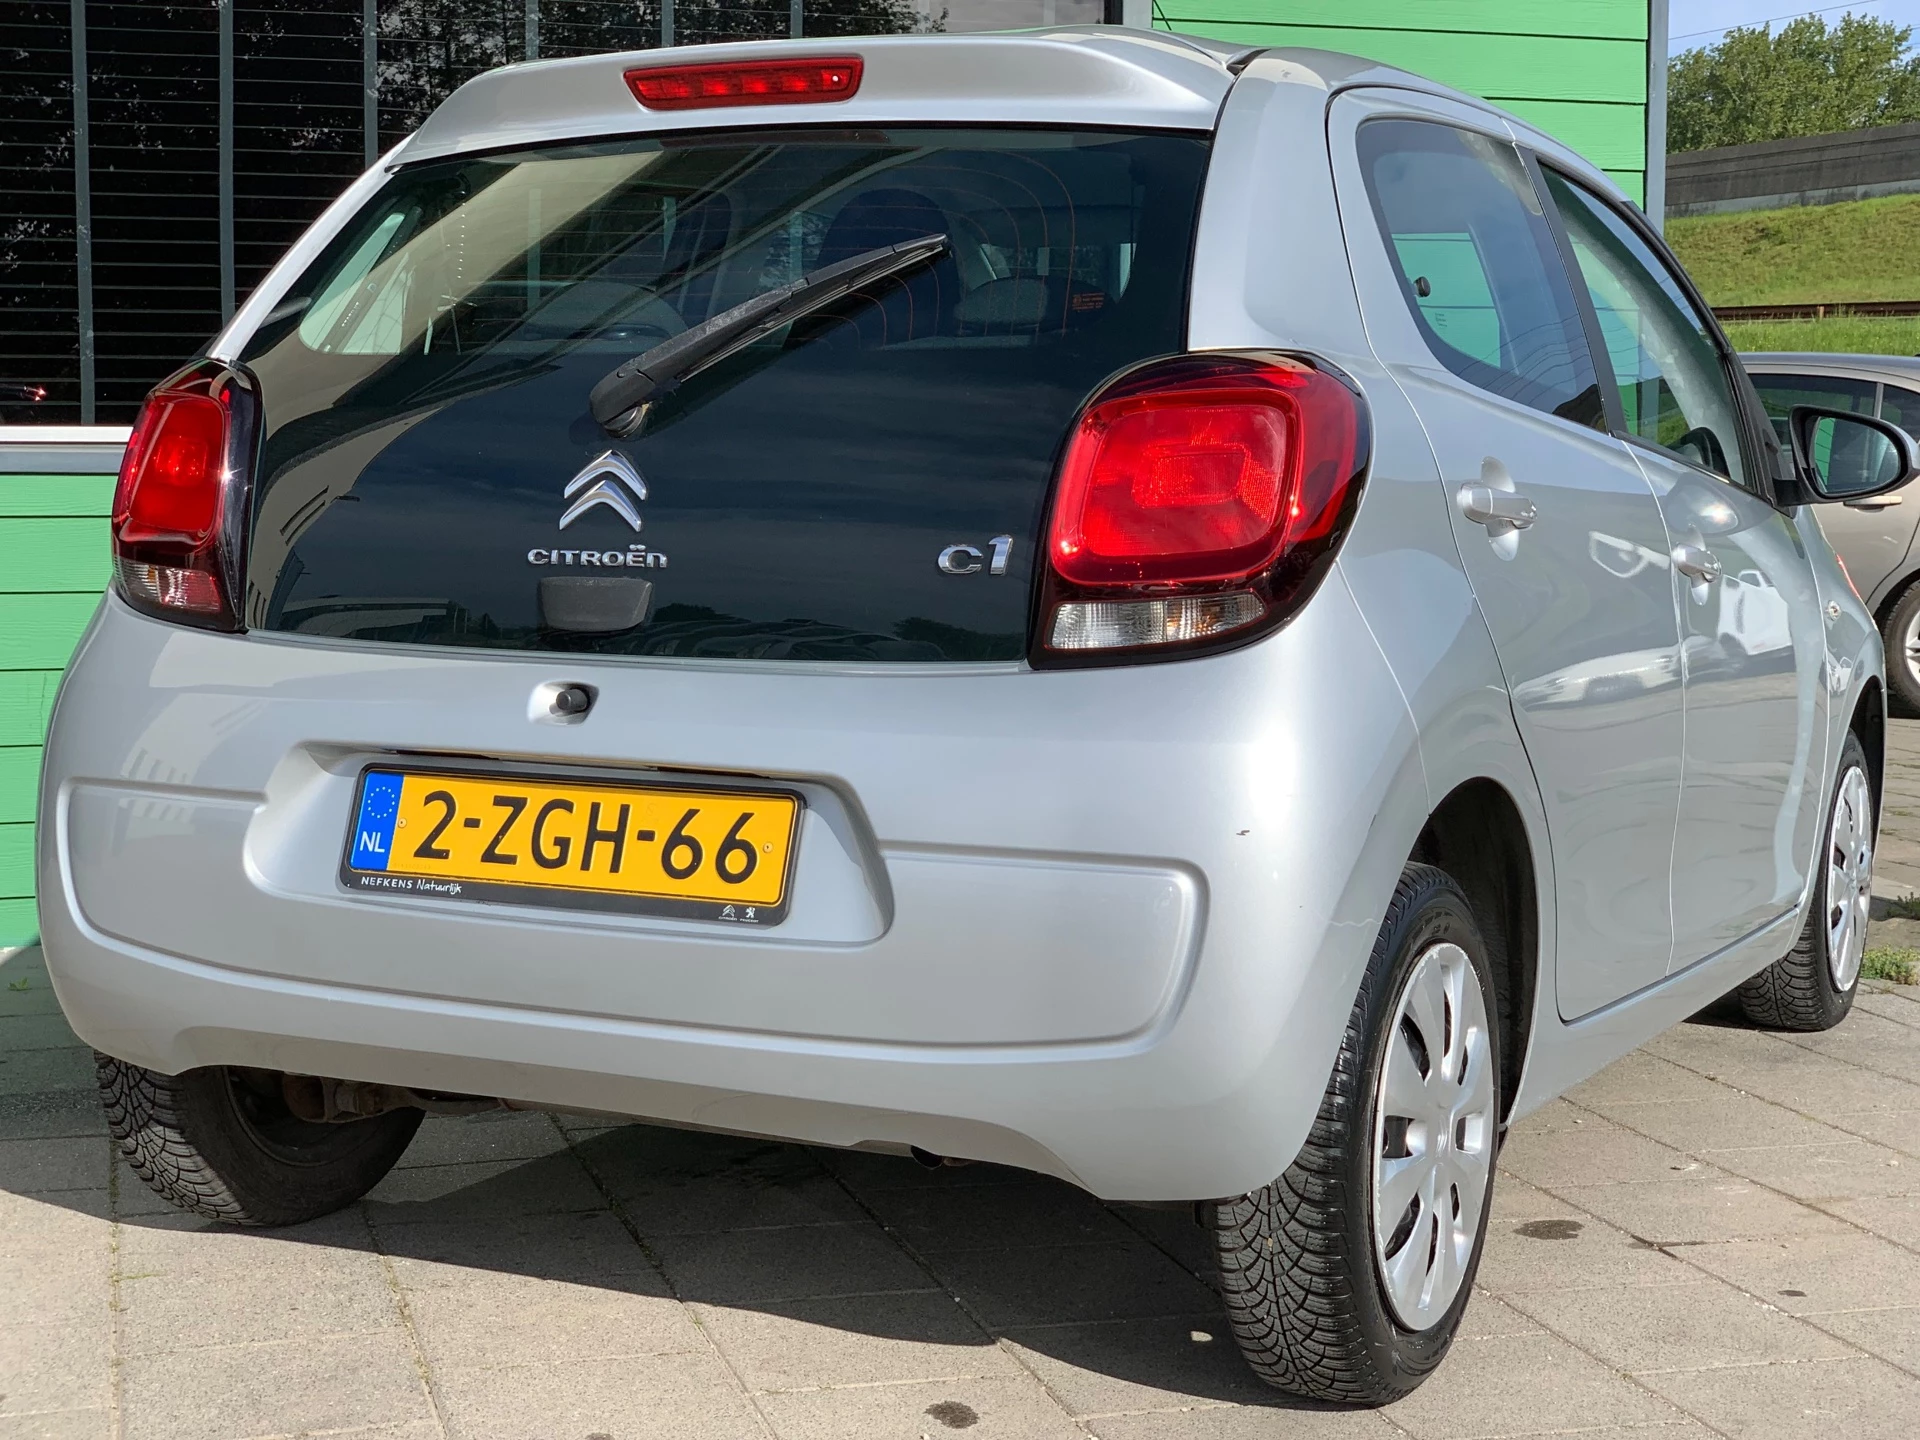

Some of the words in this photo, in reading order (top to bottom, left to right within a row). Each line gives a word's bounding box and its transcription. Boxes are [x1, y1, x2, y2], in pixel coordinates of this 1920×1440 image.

[360, 831, 385, 853] NL
[413, 790, 758, 884] 2-ZGH-66
[361, 876, 413, 889] NEFKENS
[416, 879, 462, 895] Natuurlijk
